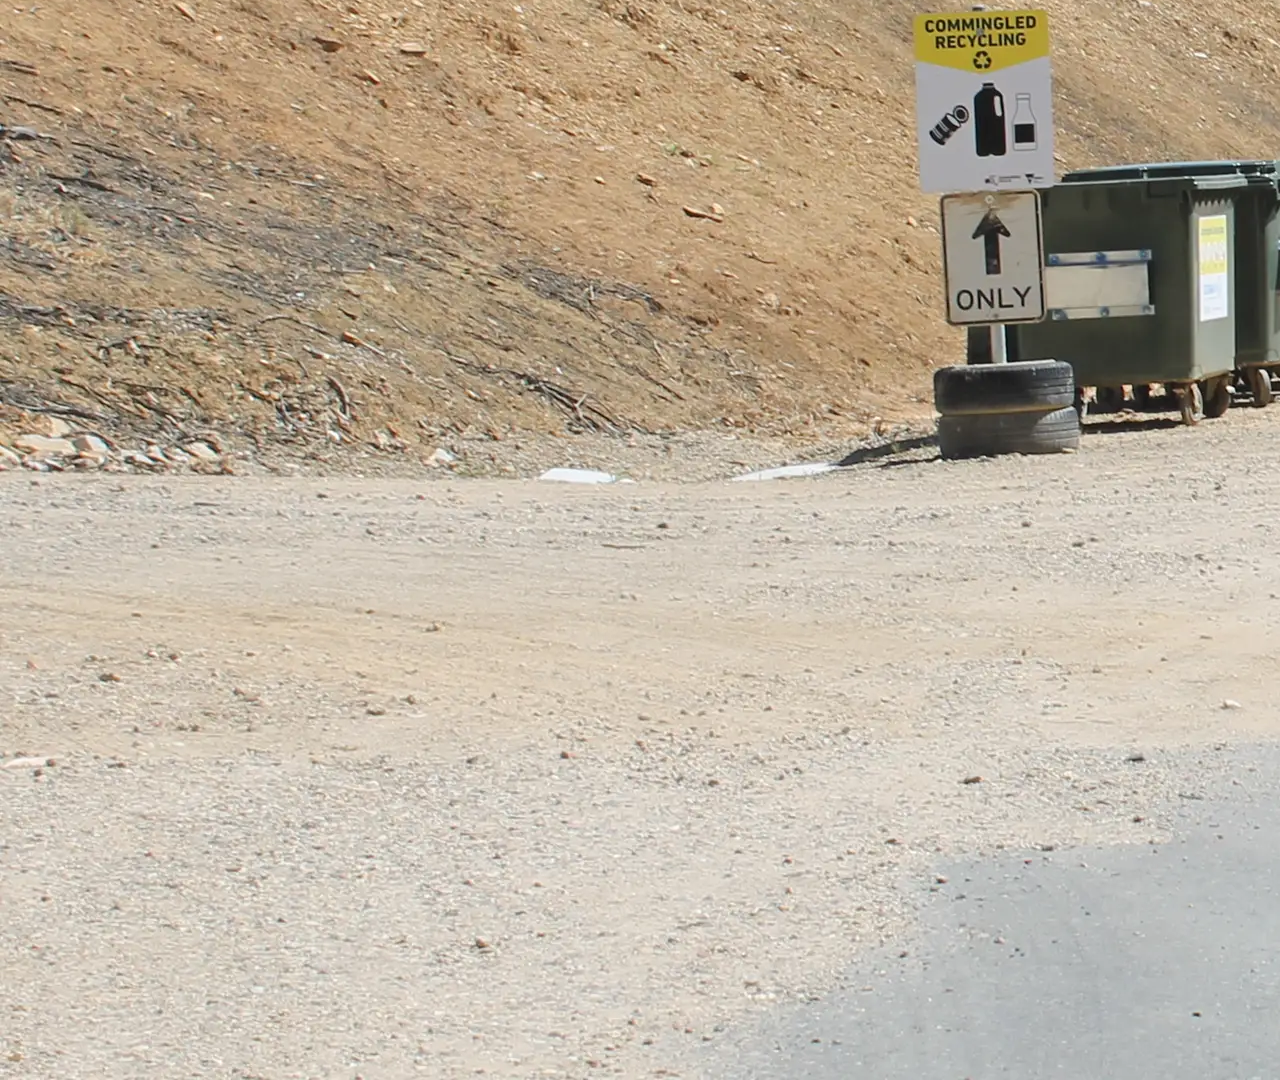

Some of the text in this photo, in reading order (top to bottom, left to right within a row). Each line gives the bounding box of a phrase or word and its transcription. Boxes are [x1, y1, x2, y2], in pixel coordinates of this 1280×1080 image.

[924, 15, 1037, 33] COMMINGLED
[935, 32, 1027, 49] RECYCLING
[956, 286, 1032, 310] ONLY
